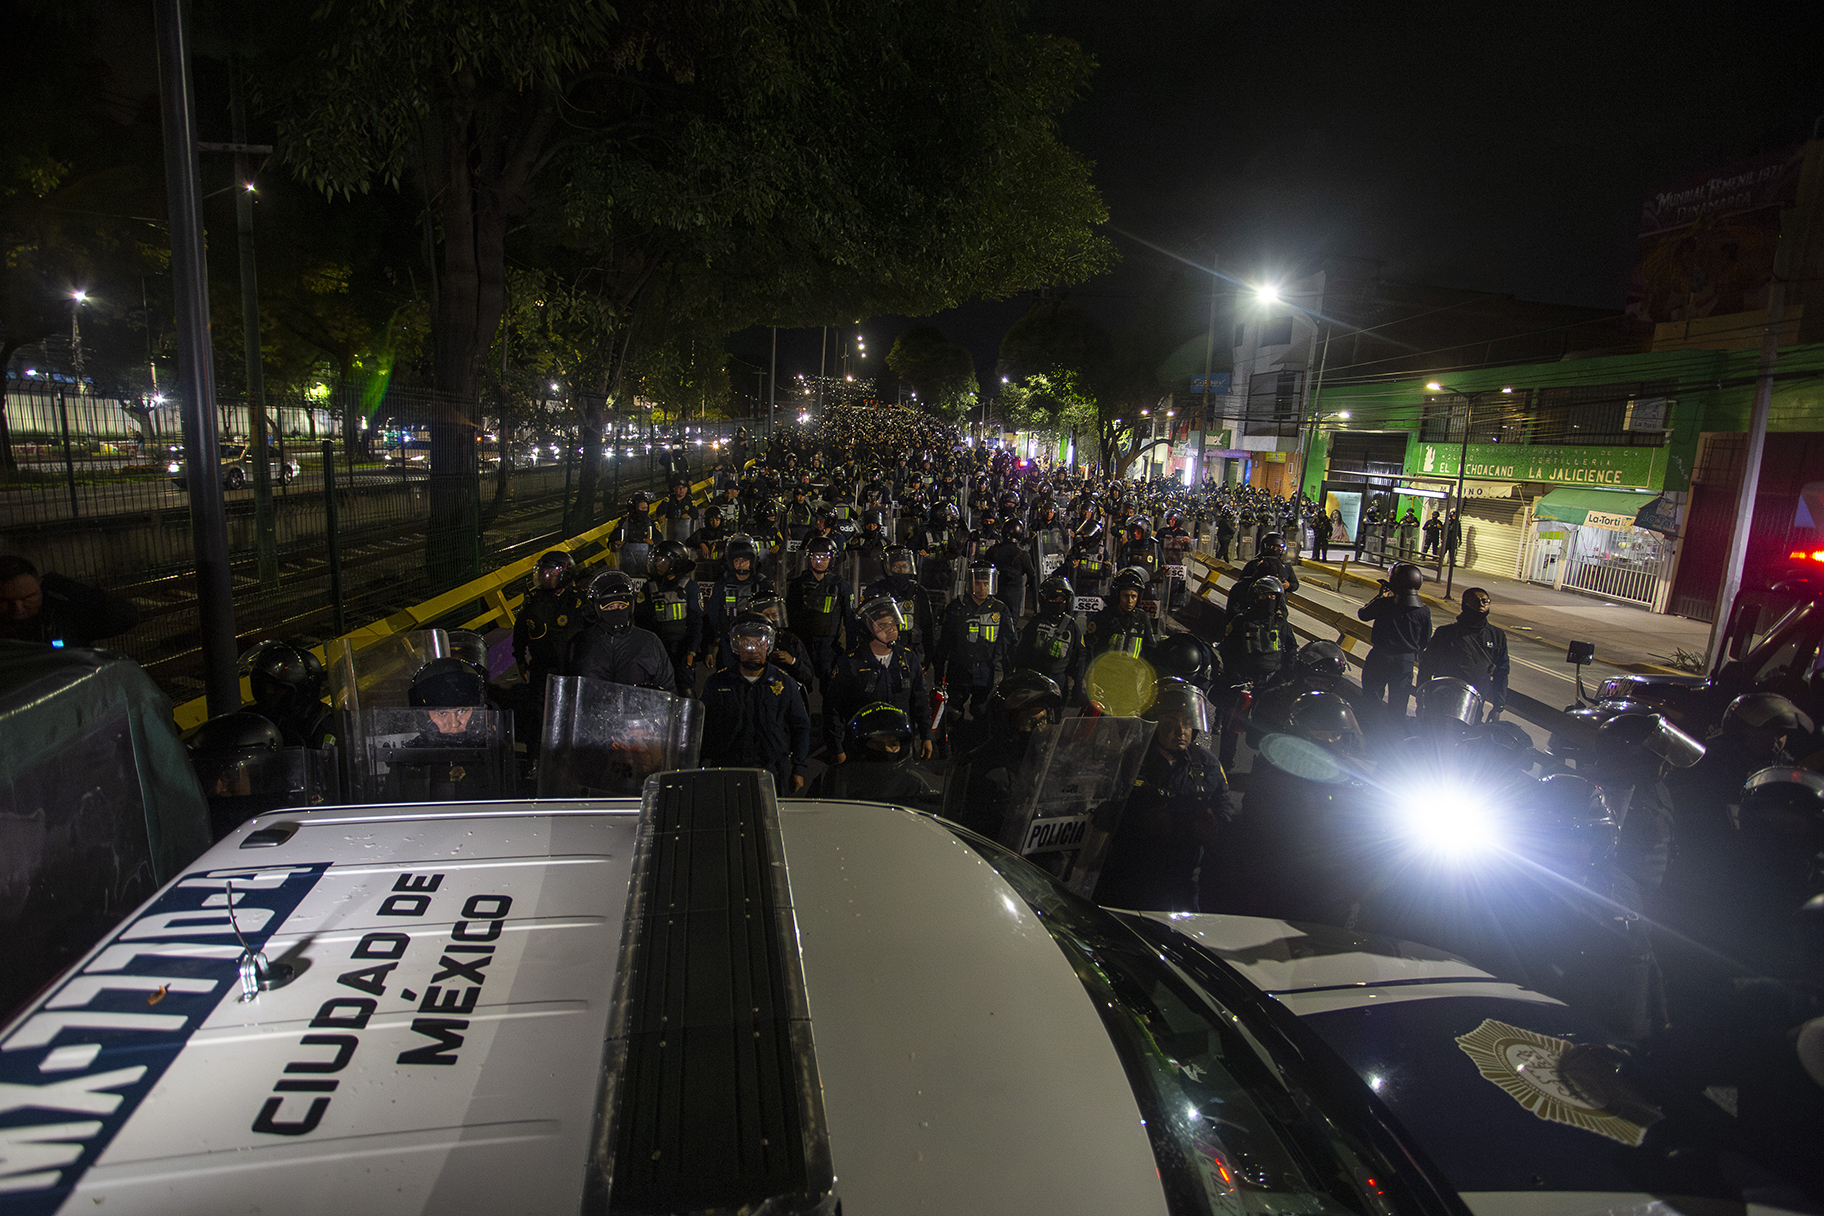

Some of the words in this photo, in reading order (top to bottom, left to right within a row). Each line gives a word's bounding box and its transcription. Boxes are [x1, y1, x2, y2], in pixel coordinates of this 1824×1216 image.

[1440, 463, 1450, 473] EL
[1458, 463, 1514, 477] CHOACANO
[1528, 466, 1542, 479] LA
[1548, 467, 1623, 484] JALICIENCE
[1440, 486, 1483, 496] MINO
[1027, 820, 1087, 848] POLICIA
[396, 894, 514, 1065] MÉXICO
[252, 932, 411, 1136] CIUDAD
[376, 873, 445, 916] DE
